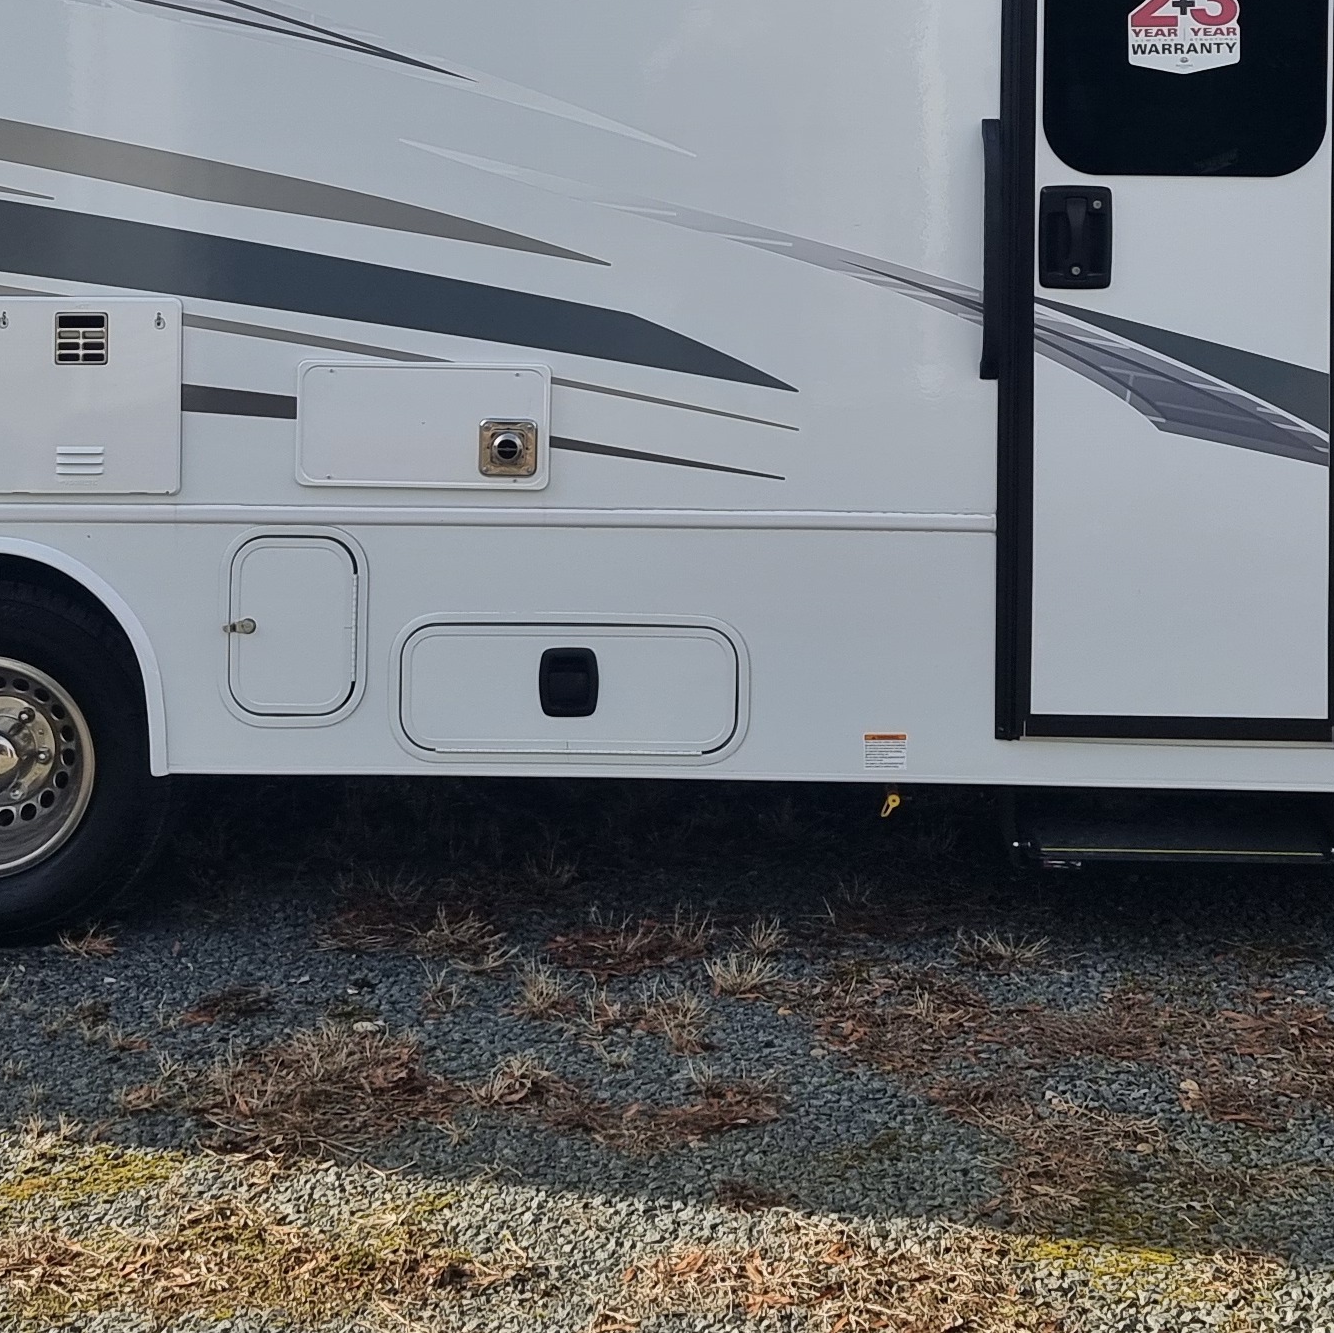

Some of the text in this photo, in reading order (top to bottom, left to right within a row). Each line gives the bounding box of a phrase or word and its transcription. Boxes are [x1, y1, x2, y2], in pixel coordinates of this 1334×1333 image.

[1130, 27, 1238, 38] YEAR YEAR
[1131, 41, 1238, 56] WARRANTY
